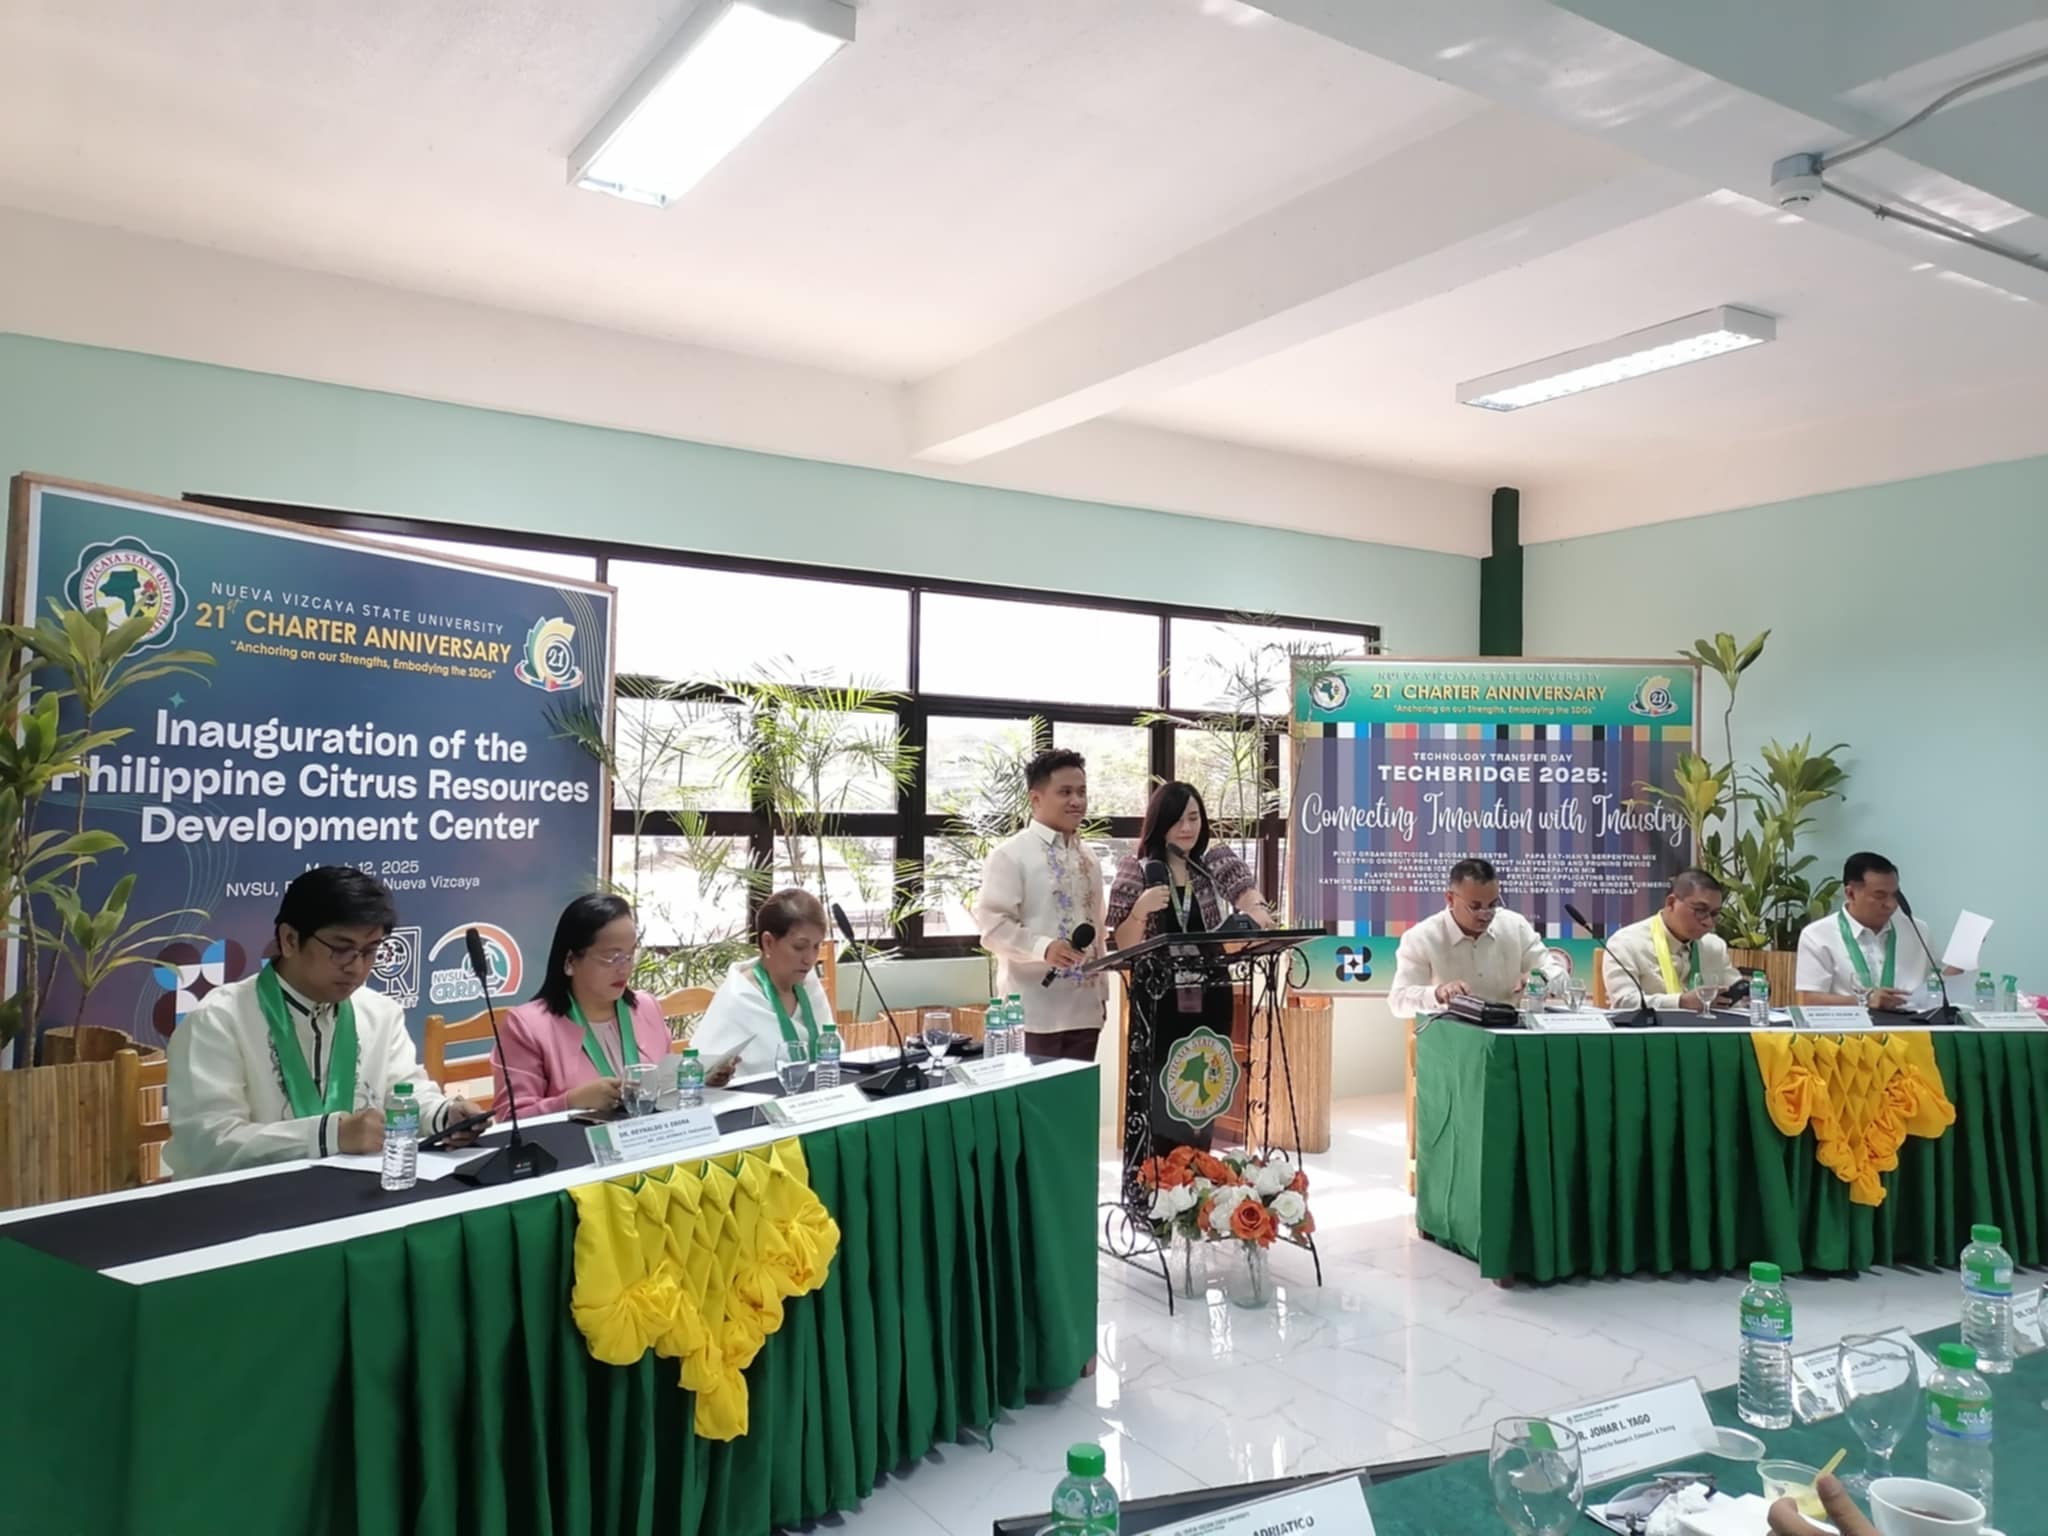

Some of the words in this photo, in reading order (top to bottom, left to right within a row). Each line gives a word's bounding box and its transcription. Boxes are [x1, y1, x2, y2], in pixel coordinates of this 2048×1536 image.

[124, 553, 158, 571] STATE
[211, 582, 273, 602] NUEVA
[282, 591, 355, 615] VIZCAYA
[362, 604, 411, 622] STATE
[417, 612, 504, 635] UNIVERSITY
[245, 609, 357, 645] CHARTER
[363, 626, 512, 664] ANNIVERSARY
[301, 648, 316, 660] on
[318, 650, 337, 662] our
[339, 652, 391, 670] Strengths,
[393, 658, 449, 677] Embodying
[451, 666, 466, 677] the
[547, 649, 564, 668] 21
[1527, 672, 1601, 682] UNIVERSITY
[1402, 683, 1480, 700] CHARTER
[1485, 685, 1607, 702] ANNIVERSARY
[156, 709, 418, 760] Inauguration
[429, 730, 466, 760] of
[475, 732, 528, 762] the
[1413, 752, 1485, 761] TECHNOLOGY
[1490, 753, 1547, 762] TRANSFER
[1550, 753, 1573, 762] DAY
[300, 763, 418, 799] Citrus
[428, 767, 589, 803] Resources
[1377, 765, 1531, 782] TECHBRIDGE
[1539, 767, 1608, 783] 2025:
[141, 806, 418, 850] Development
[429, 809, 540, 842] Center
[1301, 792, 1418, 842] Connecting
[1423, 792, 1533, 836] Innovation
[1539, 797, 1586, 834] with
[1592, 793, 1687, 847] Industry
[358, 861, 377, 877] 12,
[381, 861, 419, 875] 2025
[226, 882, 279, 898] NVSU,
[382, 876, 426, 891] Nueva
[430, 875, 480, 892] Vizcaya
[433, 971, 464, 984] NVSU
[1589, 1422, 1619, 1439] JONAR
[1626, 1413, 1651, 1429] YAGO
[1252, 1515, 1315, 1536] ADRIATICO
